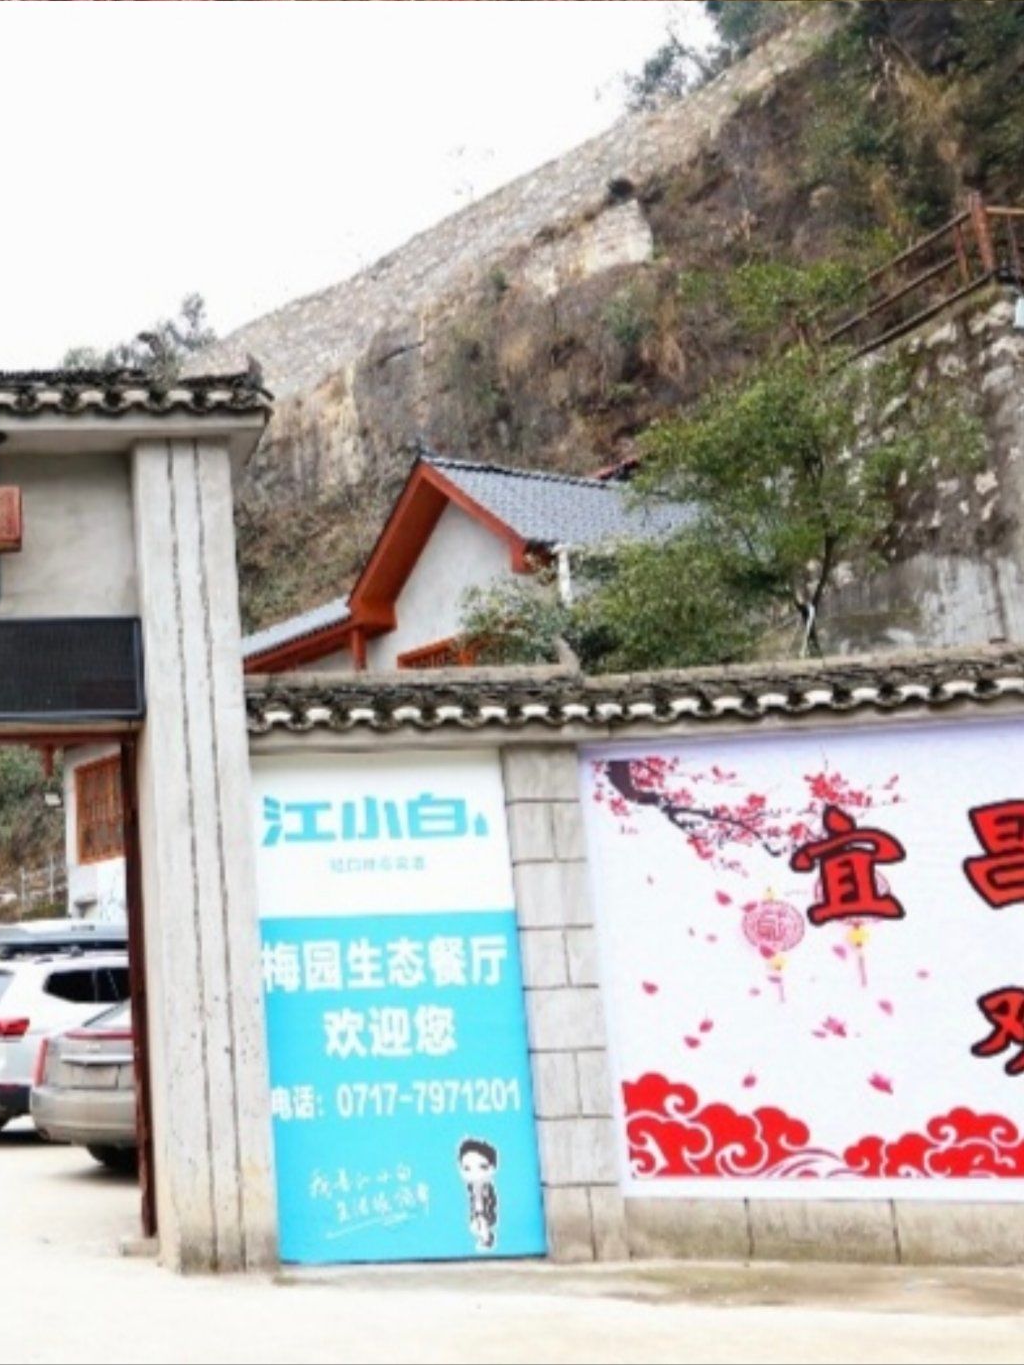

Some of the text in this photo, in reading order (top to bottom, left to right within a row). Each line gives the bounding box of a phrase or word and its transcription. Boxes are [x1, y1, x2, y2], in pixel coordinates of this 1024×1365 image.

[262, 791, 470, 846] 江小白
[323, 1003, 458, 1059] 欢迎您
